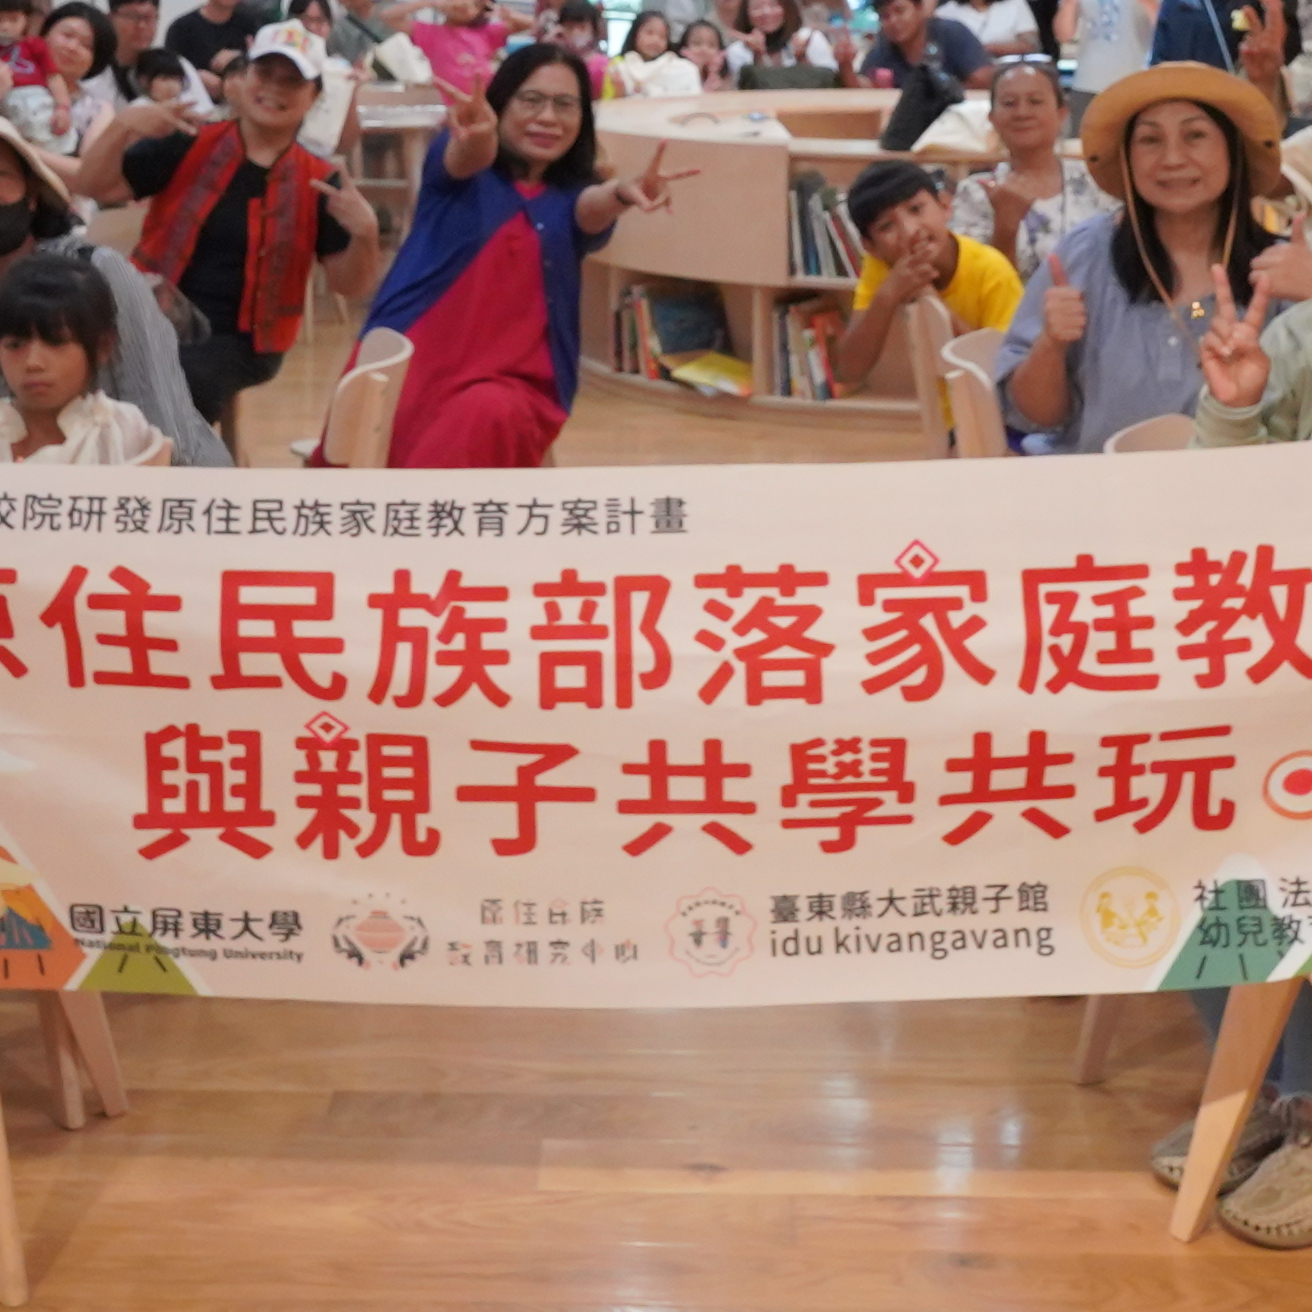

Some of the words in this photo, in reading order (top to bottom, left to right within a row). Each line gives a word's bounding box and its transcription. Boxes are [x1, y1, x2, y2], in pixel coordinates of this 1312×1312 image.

[133, 712, 1238, 862] 與親子共學共玩
[68, 902, 304, 943] 國立屏東大學
[769, 881, 1050, 925] 臺東縣大武親子館
[222, 945, 305, 964] University
[770, 928, 823, 958] idu
[834, 925, 1056, 960] kivangavang
